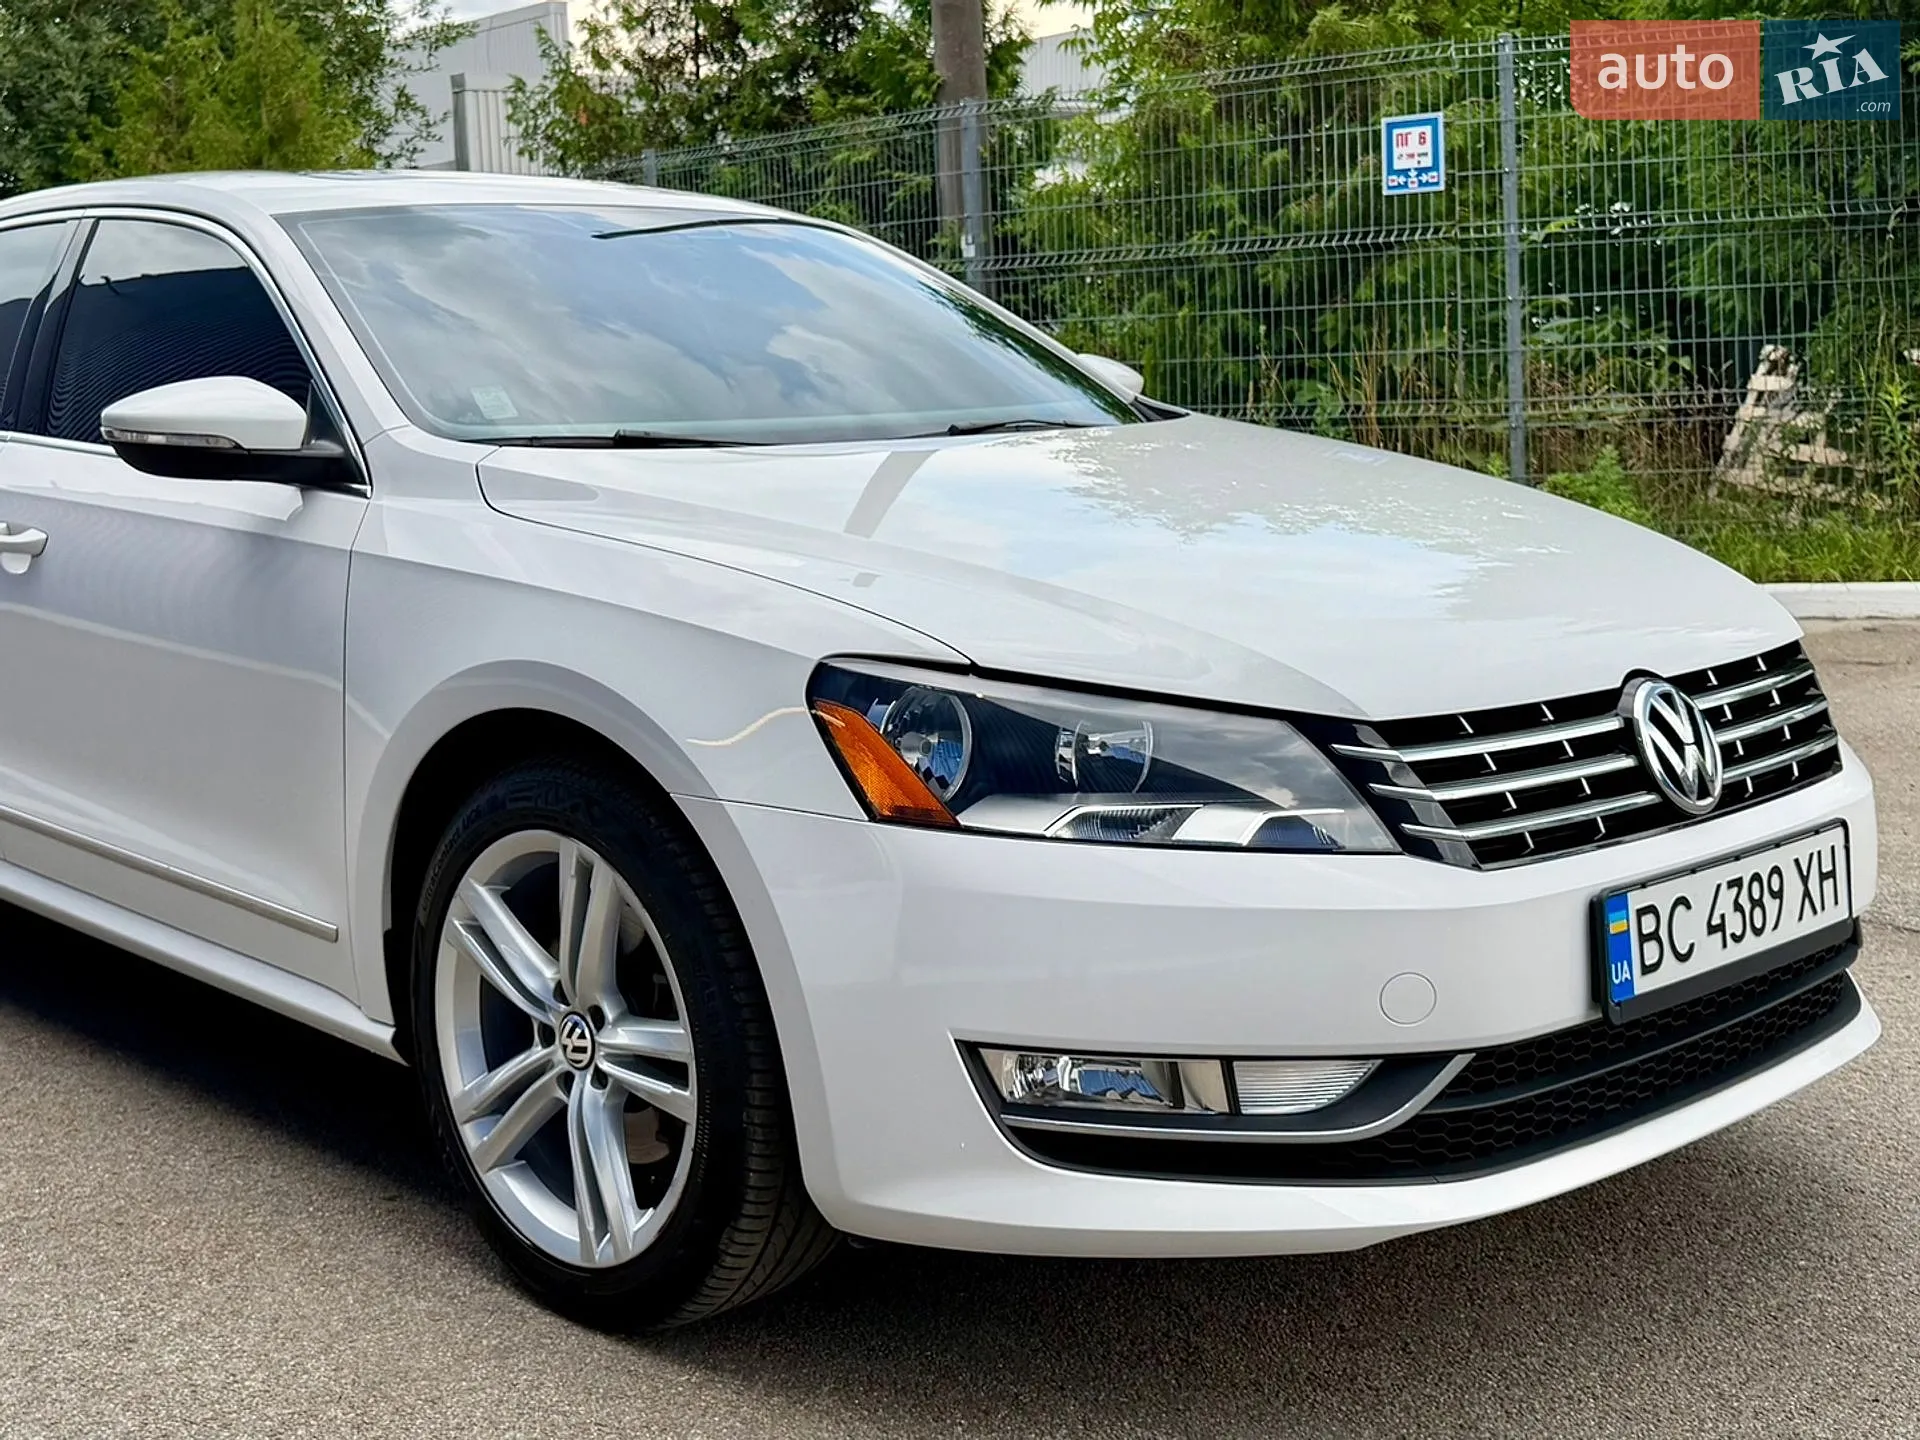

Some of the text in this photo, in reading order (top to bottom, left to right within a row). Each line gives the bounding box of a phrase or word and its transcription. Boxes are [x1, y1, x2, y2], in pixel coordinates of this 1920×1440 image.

[1635, 844, 1839, 976] BC 4389 XH
[1611, 960, 1631, 984] UA
